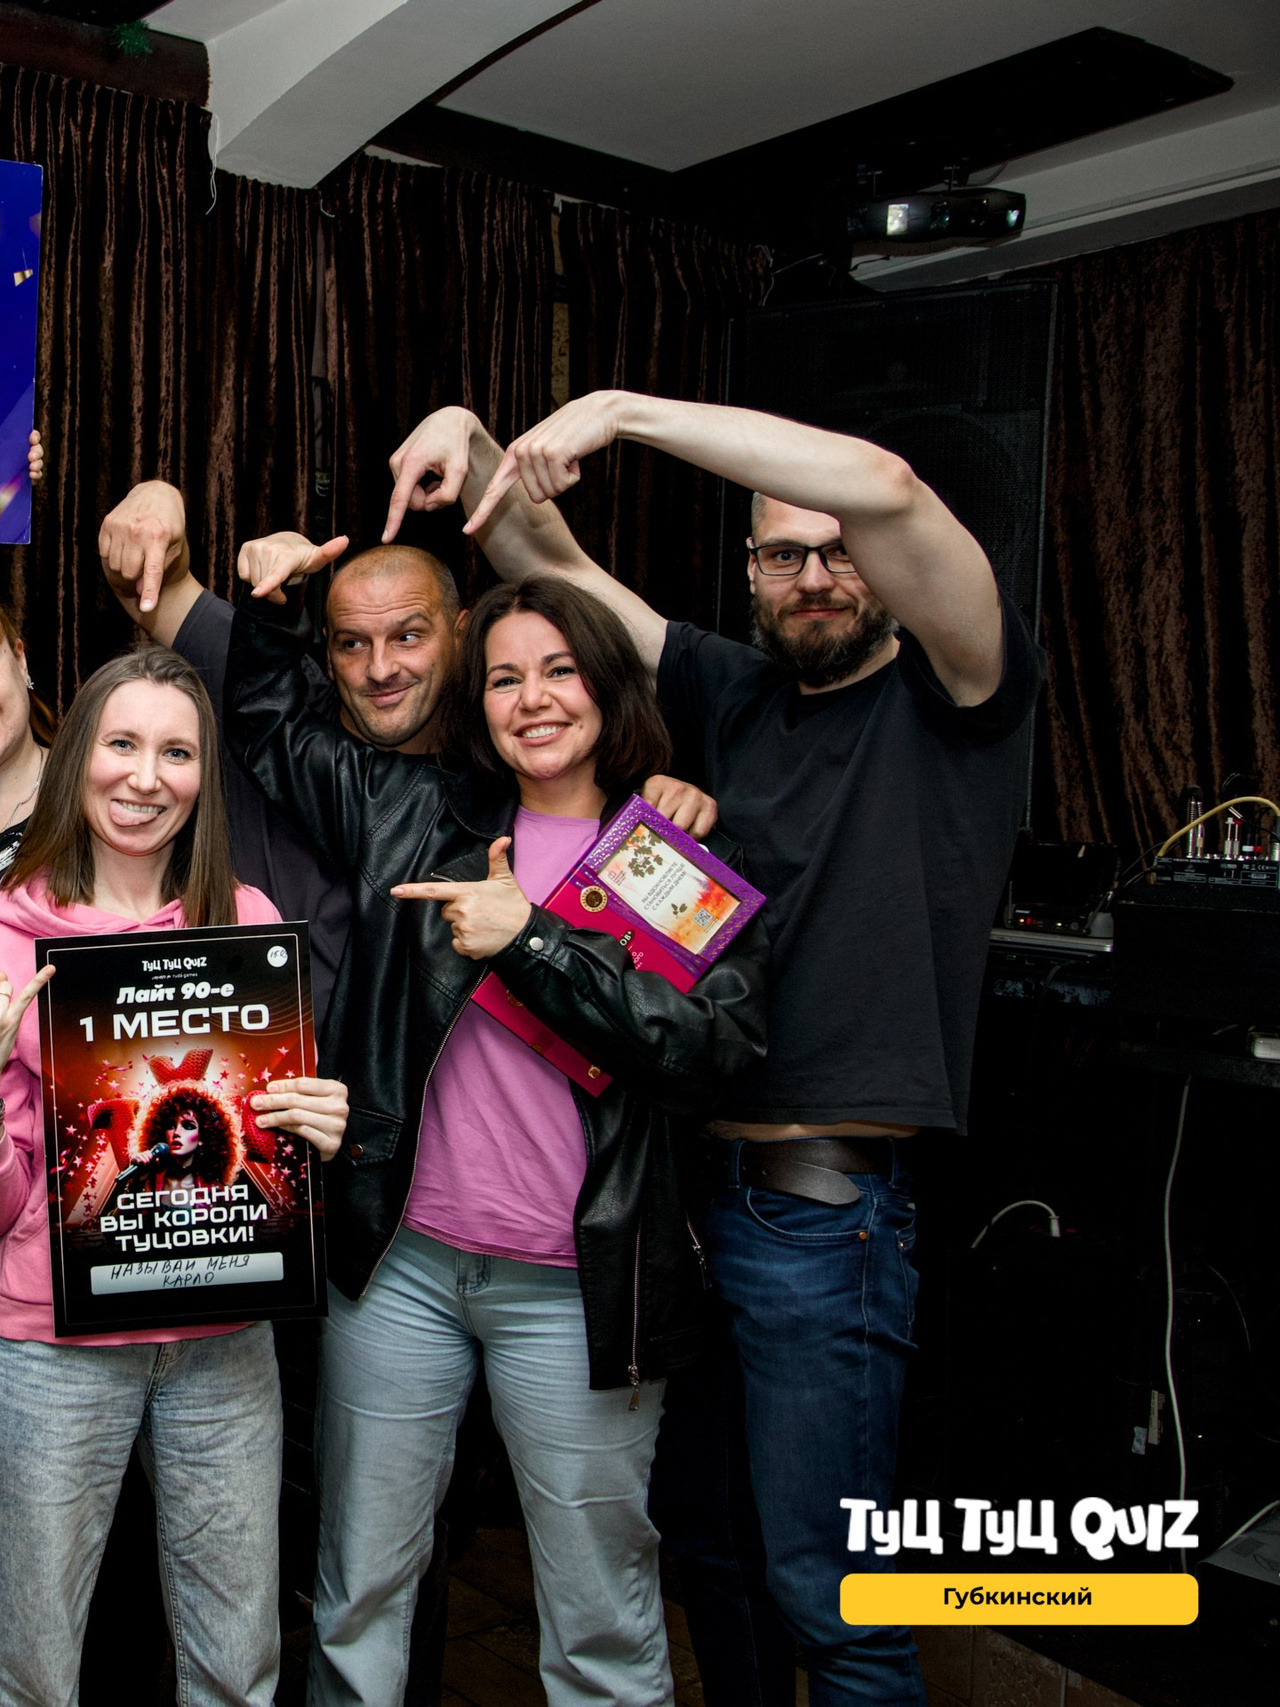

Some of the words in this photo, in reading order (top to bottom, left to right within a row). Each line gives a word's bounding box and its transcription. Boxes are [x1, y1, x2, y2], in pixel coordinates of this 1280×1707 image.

[117, 984, 175, 1004] Лайт
[181, 981, 235, 1000] 90-е
[80, 1016, 95, 1042] 1
[113, 1003, 270, 1041] МЕСТО
[117, 1184, 249, 1210] СЕГОДНЯ
[100, 1213, 144, 1233] ВЫ
[154, 1204, 268, 1228] КОРОЛИ
[115, 1226, 255, 1252] ТУЦОВКИ!
[207, 1255, 250, 1271] МЕНЯ
[163, 1272, 214, 1287] КАРЛО
